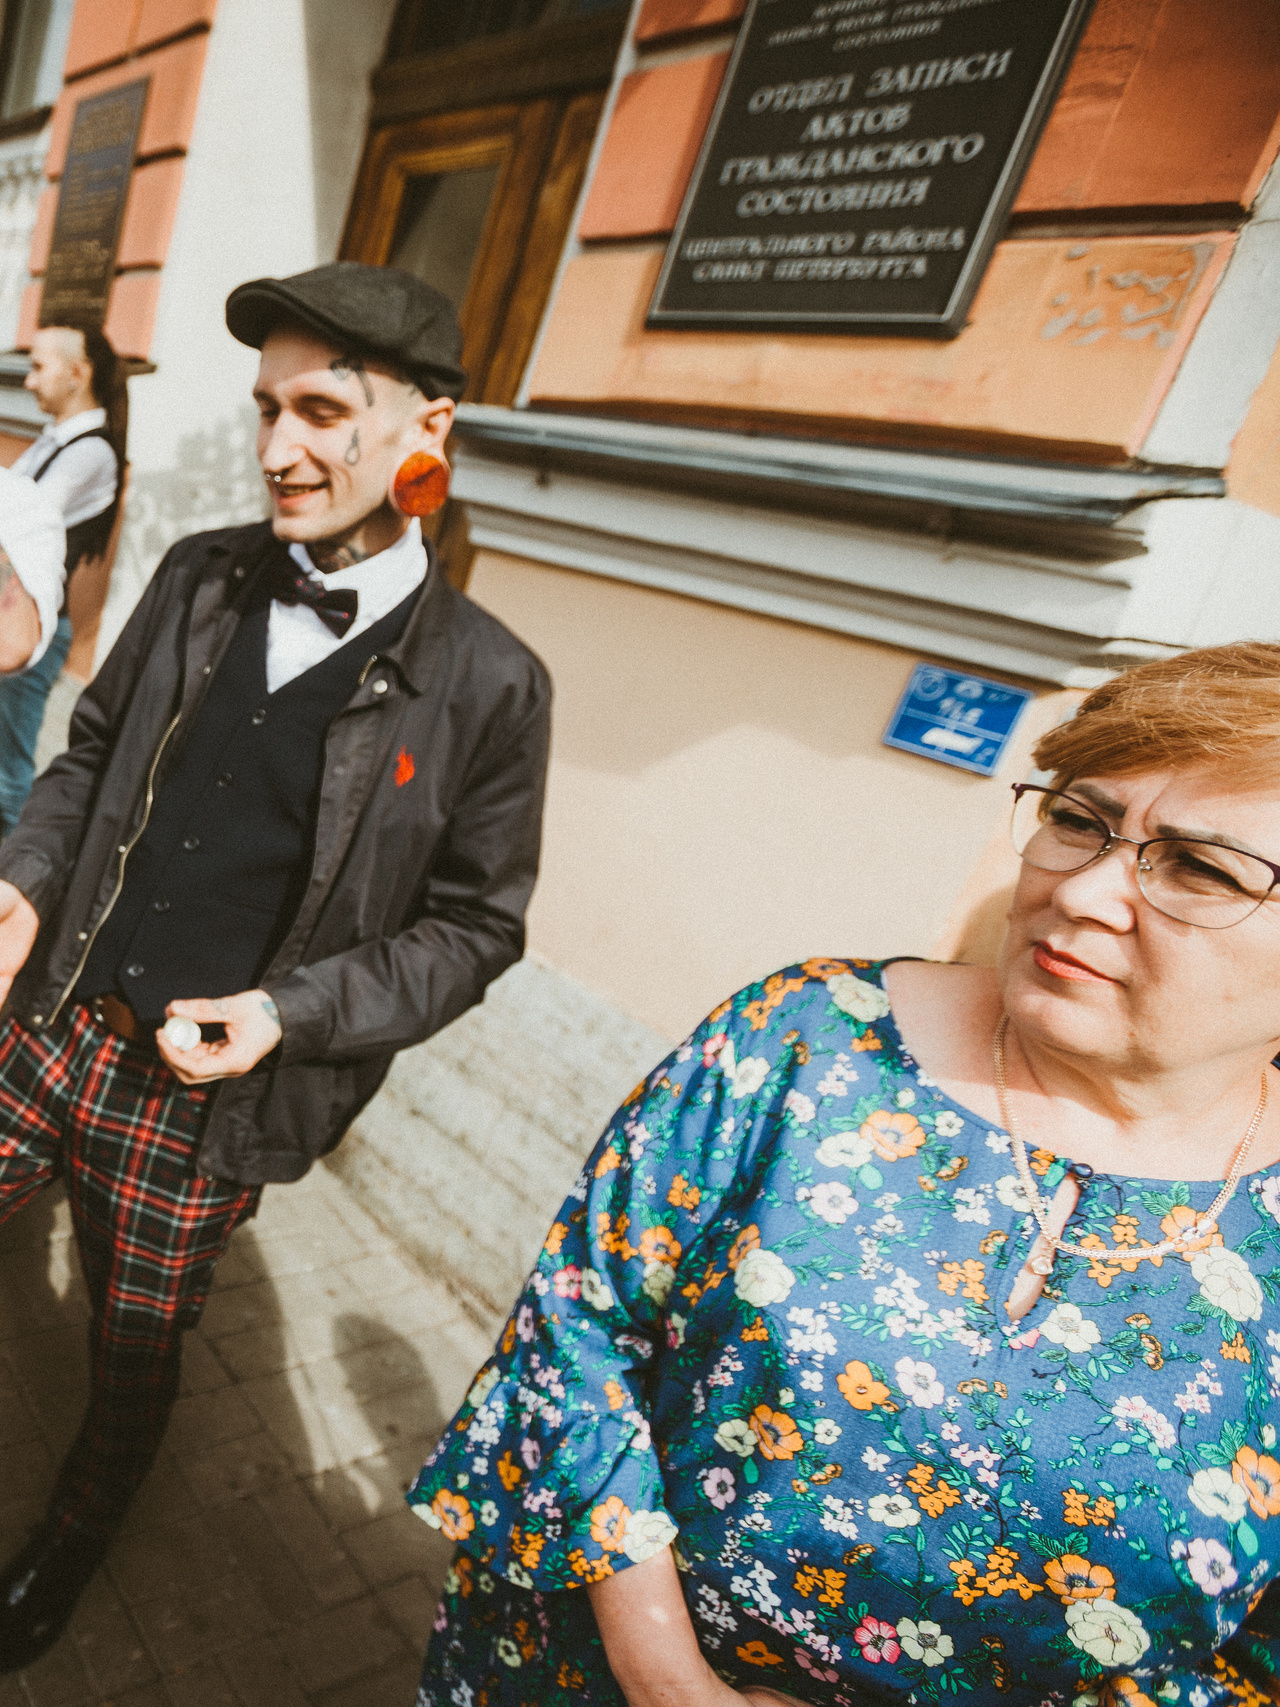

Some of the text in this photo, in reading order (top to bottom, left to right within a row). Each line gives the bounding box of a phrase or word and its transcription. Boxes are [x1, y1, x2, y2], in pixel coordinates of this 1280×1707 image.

[749, 51, 1011, 114] ОТДЕЛ ЗАПИСИ
[803, 103, 912, 141] АКТОВ
[721, 134, 984, 184] ГРАЖДАНСКОГО
[738, 178, 931, 217] СОСТОЯНИЯ
[862, 225, 966, 255] РАЙОНА
